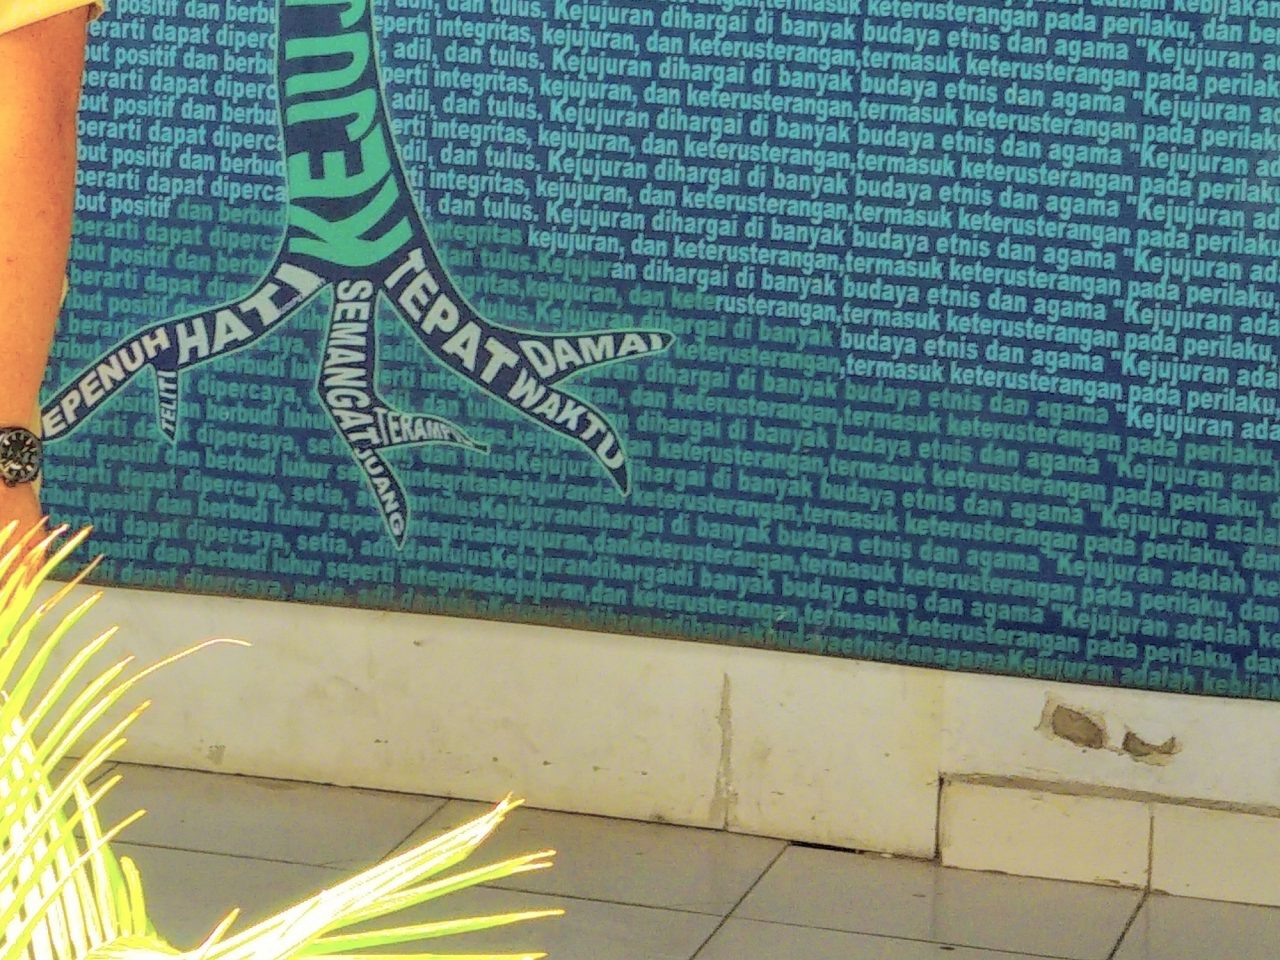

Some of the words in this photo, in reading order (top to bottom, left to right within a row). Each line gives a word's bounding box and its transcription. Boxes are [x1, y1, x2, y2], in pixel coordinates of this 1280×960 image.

[554, 0, 653, 29] Kejujuran
[661, 6, 748, 37] dihargai
[863, 20, 940, 51] budaya
[948, 29, 1000, 52] etnis
[1007, 32, 1047, 55] dan
[1054, 40, 1129, 64] agama
[862, 46, 960, 74] termasuk
[967, 53, 1140, 92] keterusterangan
[1145, 70, 1197, 95] pada
[41, 327, 170, 438] EPENUH
[323, 279, 388, 448] SEMANGAT
[384, 248, 519, 384] TEPAT
[508, 368, 625, 470] WAKTU
[519, 333, 664, 378] DAMAI
[354, 444, 405, 537] JUANG
